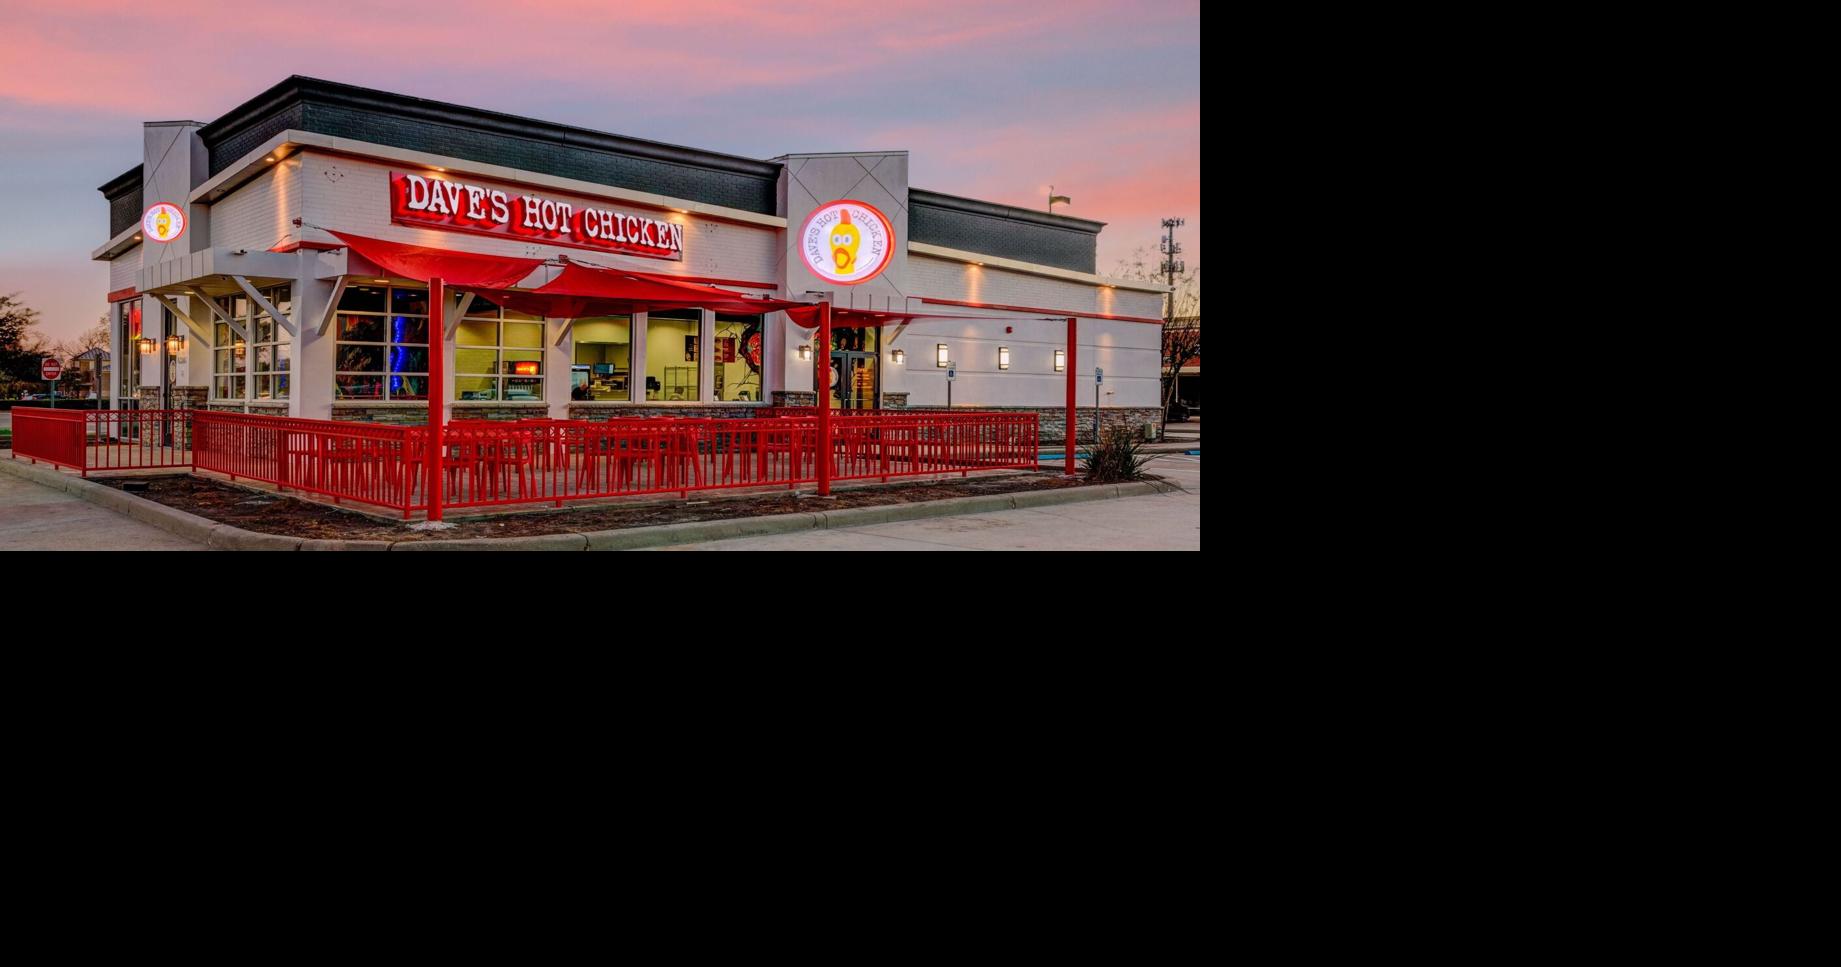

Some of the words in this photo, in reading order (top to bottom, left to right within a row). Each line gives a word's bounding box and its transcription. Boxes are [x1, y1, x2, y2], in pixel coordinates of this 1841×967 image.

[407, 174, 509, 224] DAVE'S
[521, 195, 573, 233] HOT
[584, 207, 684, 252] CHICKEN
[808, 227, 824, 265] DAVE'S
[816, 209, 838, 228] HOT
[851, 209, 882, 256] CHICKEN
